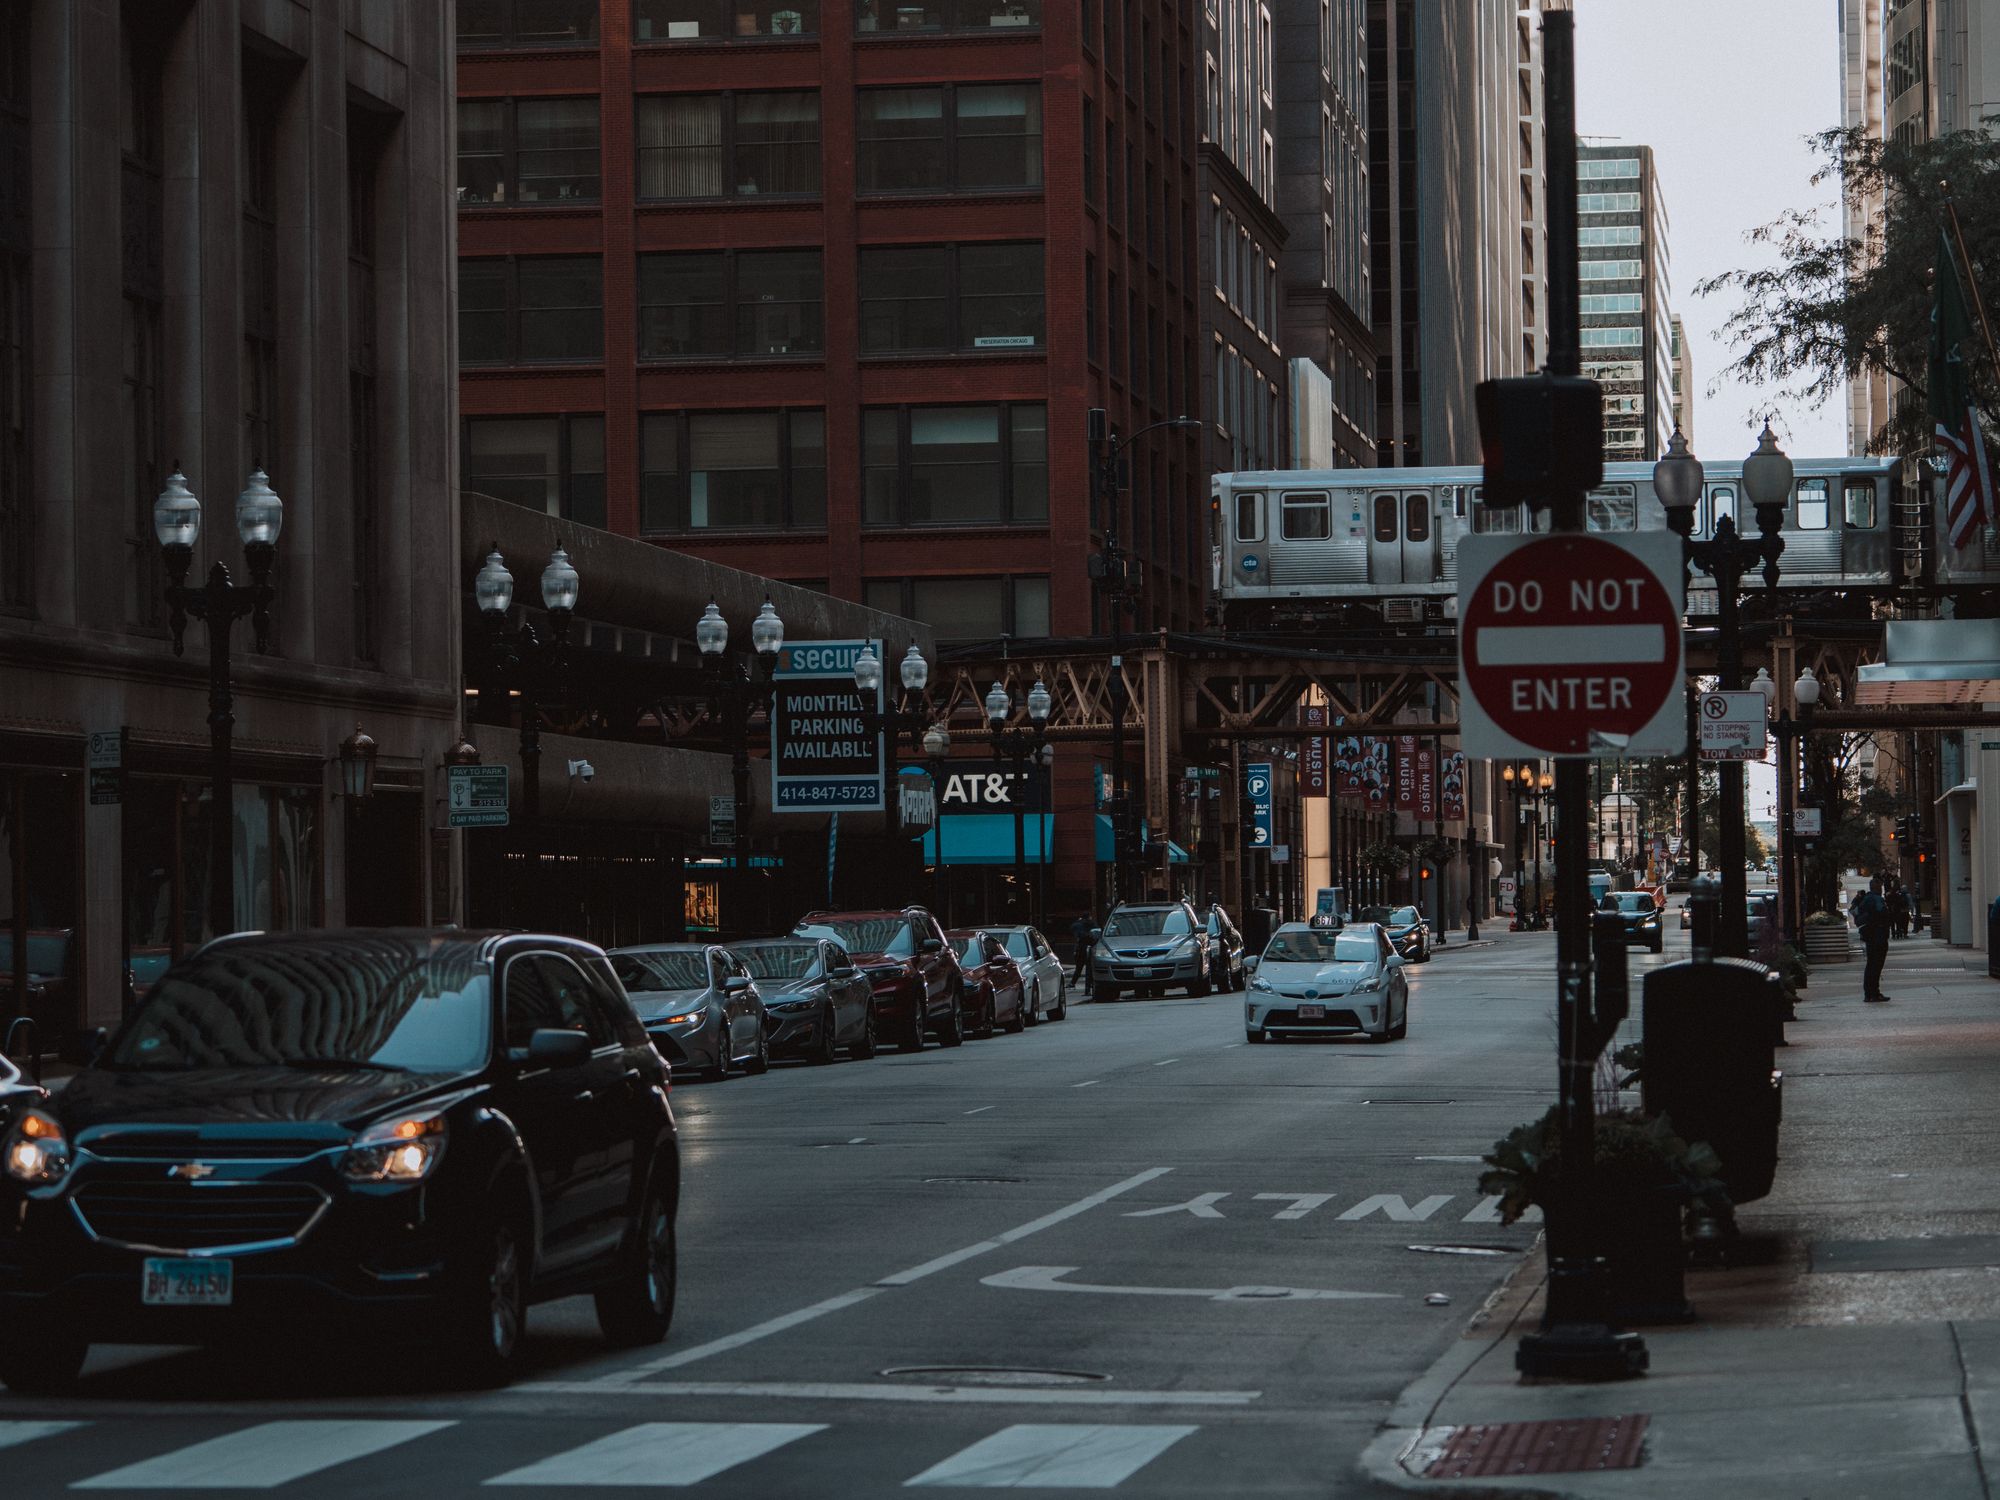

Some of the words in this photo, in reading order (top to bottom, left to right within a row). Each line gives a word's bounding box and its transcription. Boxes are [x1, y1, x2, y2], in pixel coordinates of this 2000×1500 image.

[1493, 580, 1543, 613] DO
[1570, 578, 1645, 612] NOT
[793, 648, 860, 670] secur
[786, 695, 864, 712] MONTHL
[1511, 677, 1632, 712] ENTER
[790, 718, 864, 735] PARKING
[1311, 736, 1322, 787] MUSIC
[1704, 750, 1727, 759] TOW
[1205, 767, 1219, 775] Wel
[1400, 757, 1410, 801] MUSIC
[780, 786, 876, 800] 414-847-5723
[942, 773, 1028, 803] AT&
[1422, 774, 1431, 813] MUSIC
[1500, 882, 1514, 891] FD
[1315, 915, 1336, 925] 6670
